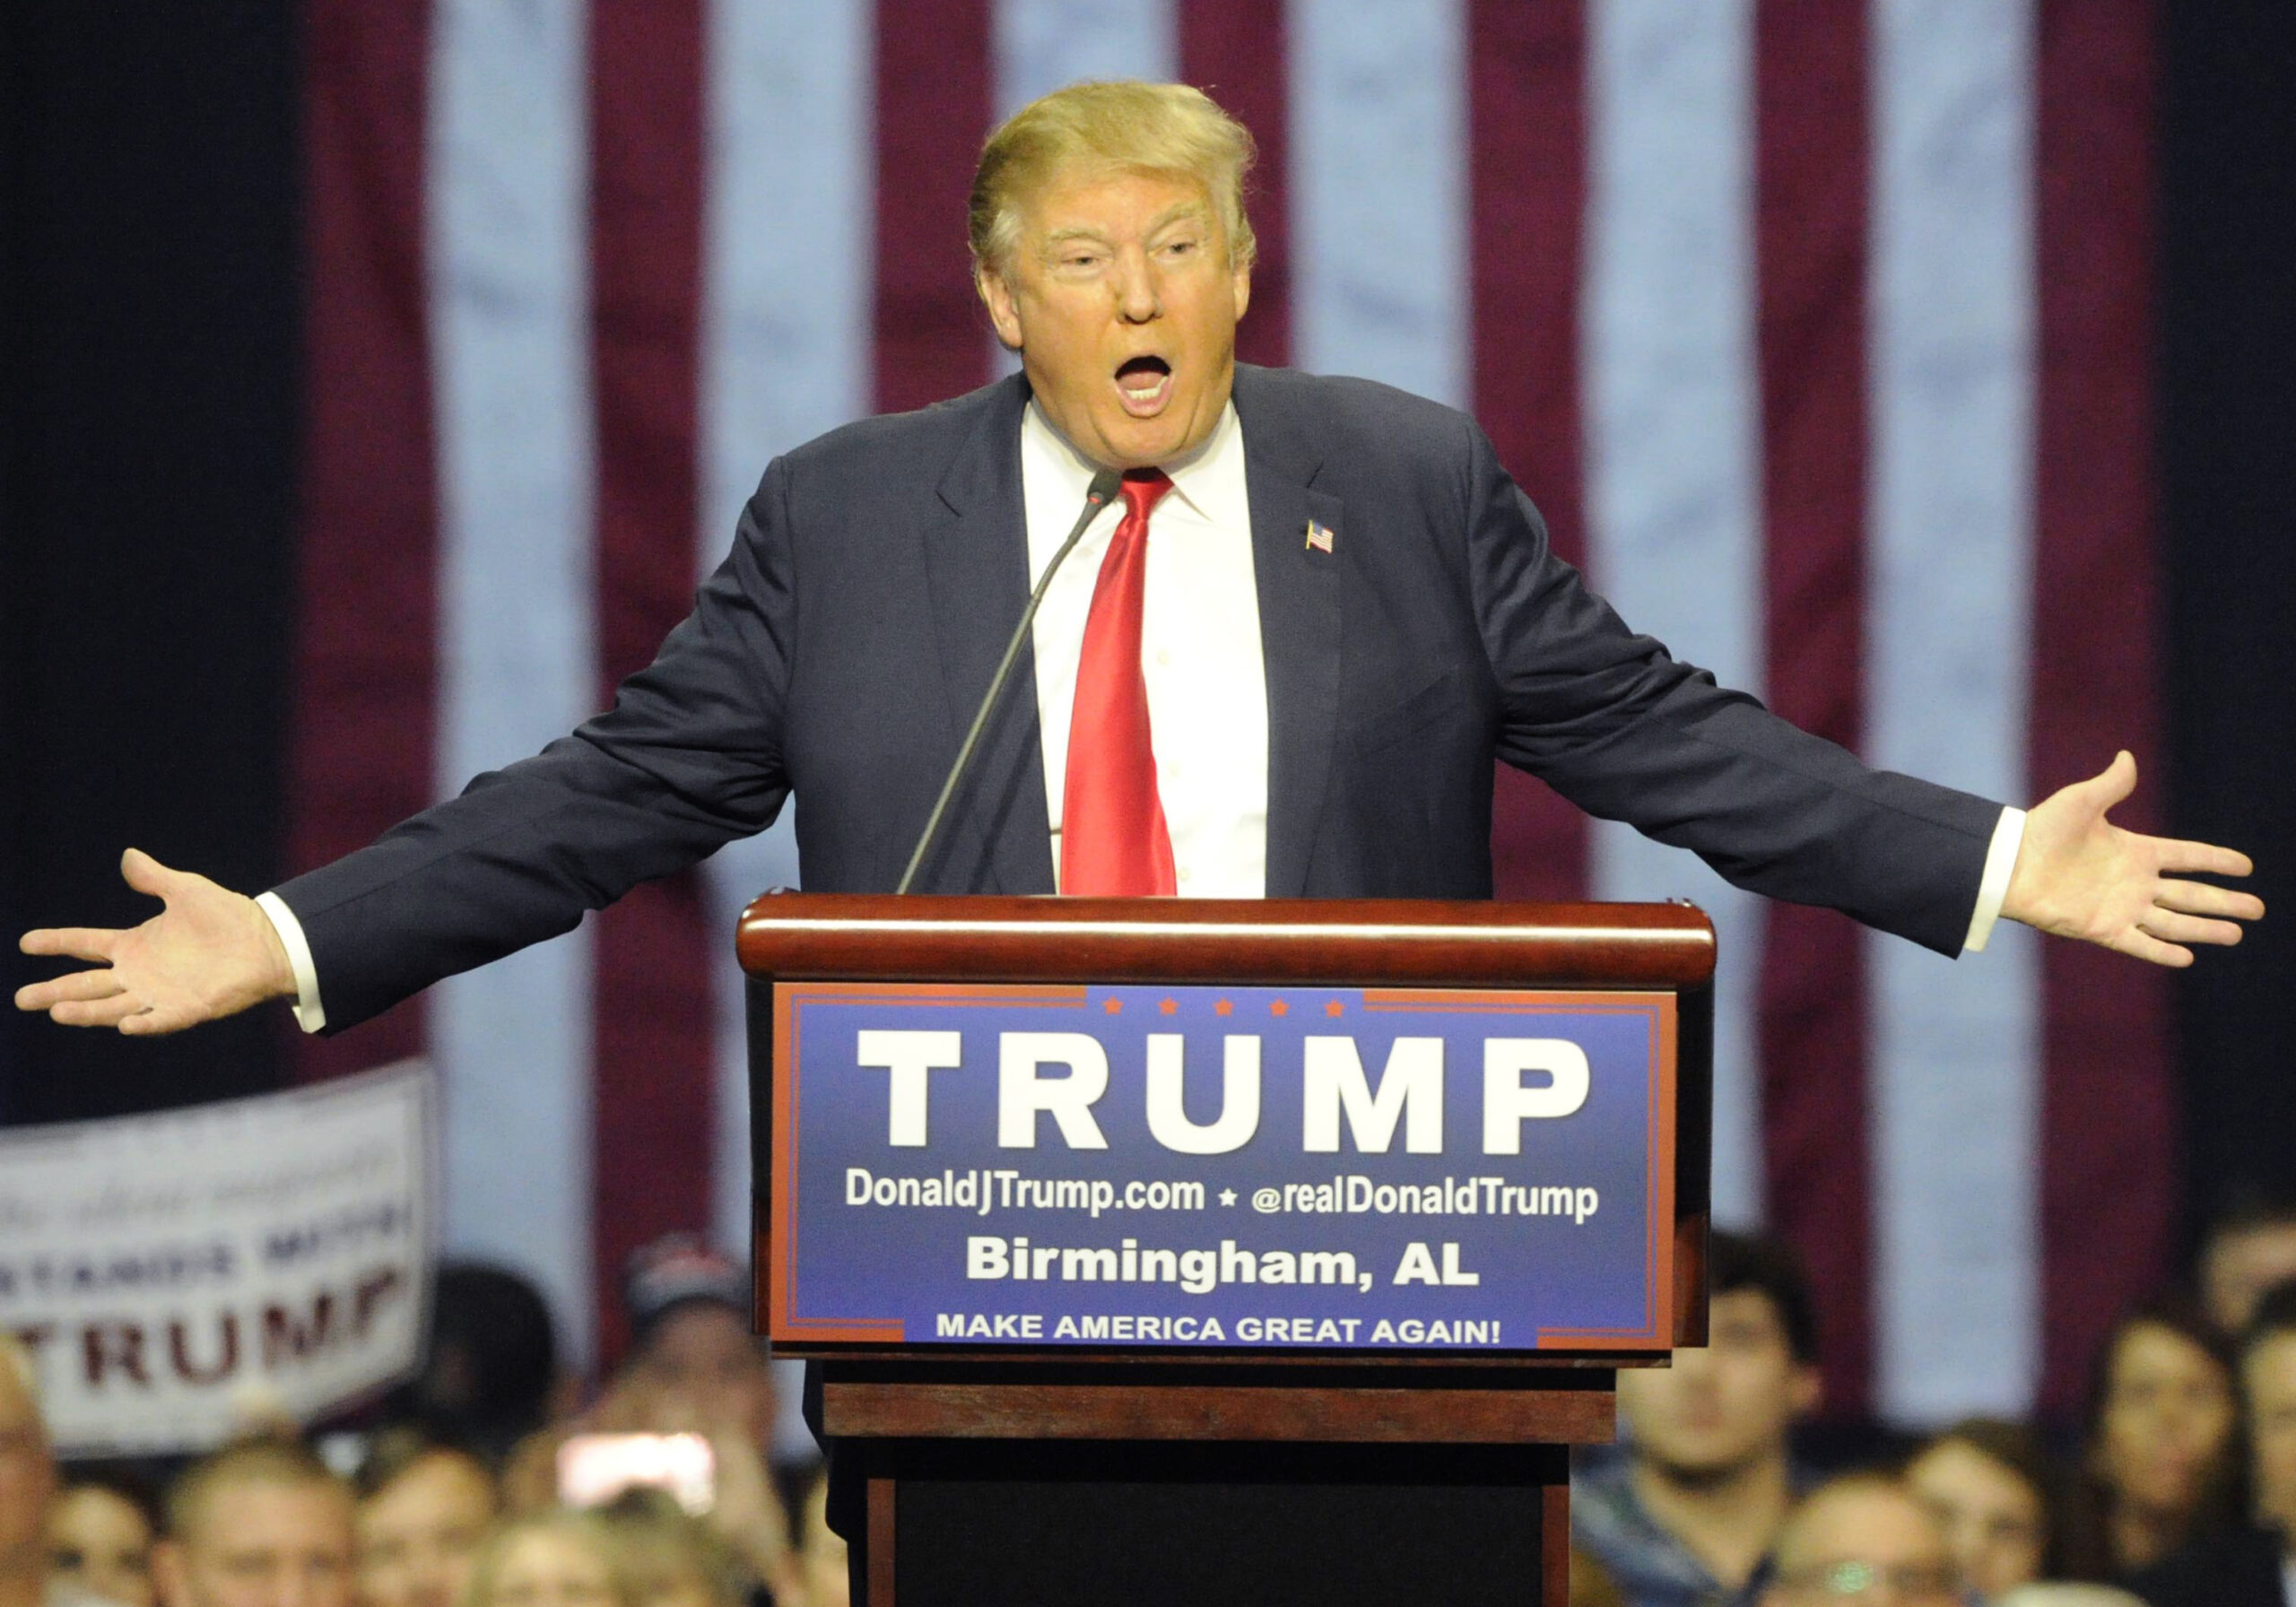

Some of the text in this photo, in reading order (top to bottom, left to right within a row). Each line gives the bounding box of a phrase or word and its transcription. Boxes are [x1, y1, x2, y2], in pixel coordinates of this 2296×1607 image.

[857, 1029, 1591, 1155] TRUMP
[846, 1168, 1599, 1226] DonaldJTrump.com @realDonaldTrump
[966, 1236, 1480, 1295] Birmingham, AL
[936, 1313, 1500, 1344] MAKE AMERICA GREAT AGAIN!
